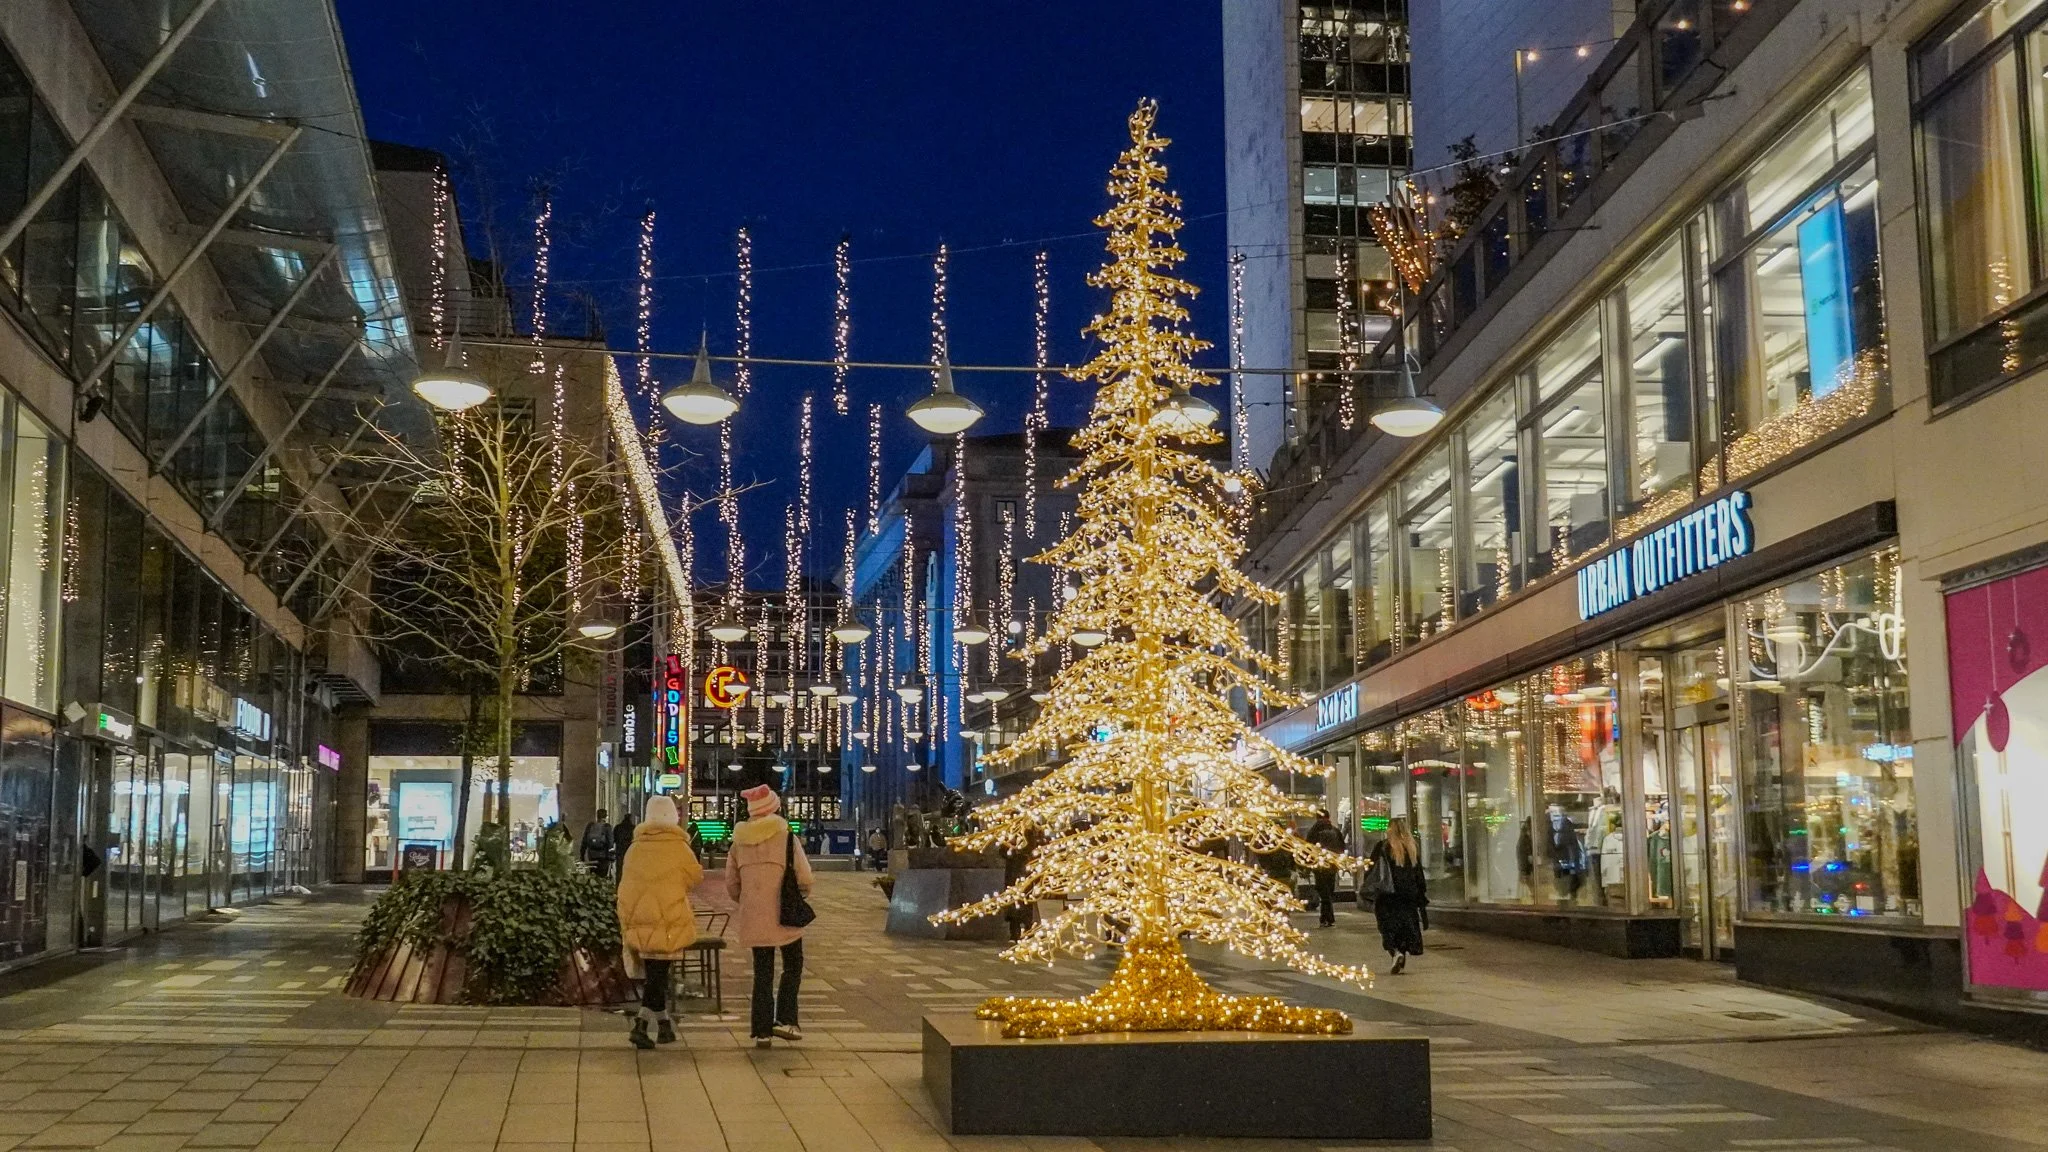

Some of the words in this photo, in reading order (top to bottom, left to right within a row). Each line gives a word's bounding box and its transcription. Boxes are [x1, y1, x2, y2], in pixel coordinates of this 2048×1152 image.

[1577, 547, 1632, 621] URBAN
[1632, 490, 1752, 597] OUTFITTERS
[623, 704, 635, 752] newbie
[667, 678, 680, 744] GODIS
